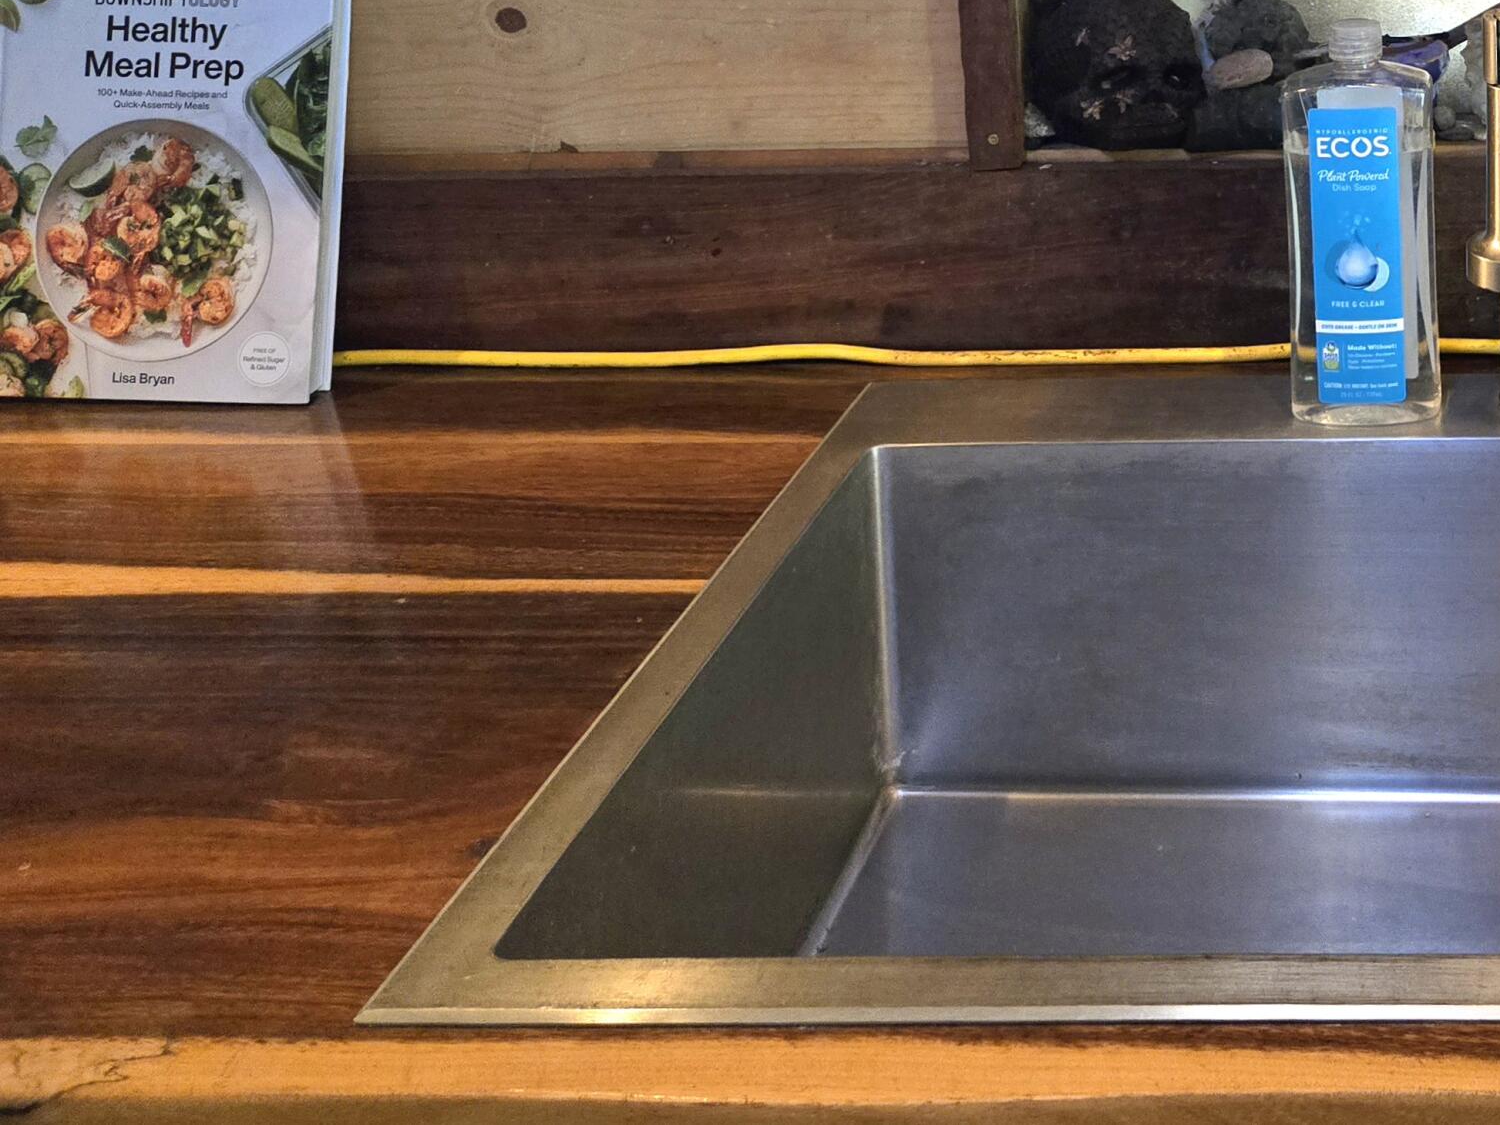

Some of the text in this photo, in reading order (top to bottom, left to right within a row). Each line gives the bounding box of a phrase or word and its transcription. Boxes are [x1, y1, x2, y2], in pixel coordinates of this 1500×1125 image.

[106, 15, 228, 50] Healthy
[84, 50, 244, 86] Meal Prep
[98, 88, 228, 99] 100+ Make-Ahead Recipes and
[113, 100, 210, 111] Quick-Assembly Meals
[1316, 135, 1390, 158] ECOS
[1317, 168, 1390, 183] Plant Powered
[1332, 183, 1377, 192] Dish Soap
[1331, 300, 1350, 308] FREE
[1359, 299, 1385, 308] CLEAR
[112, 372, 175, 386] Lisa Bryan
